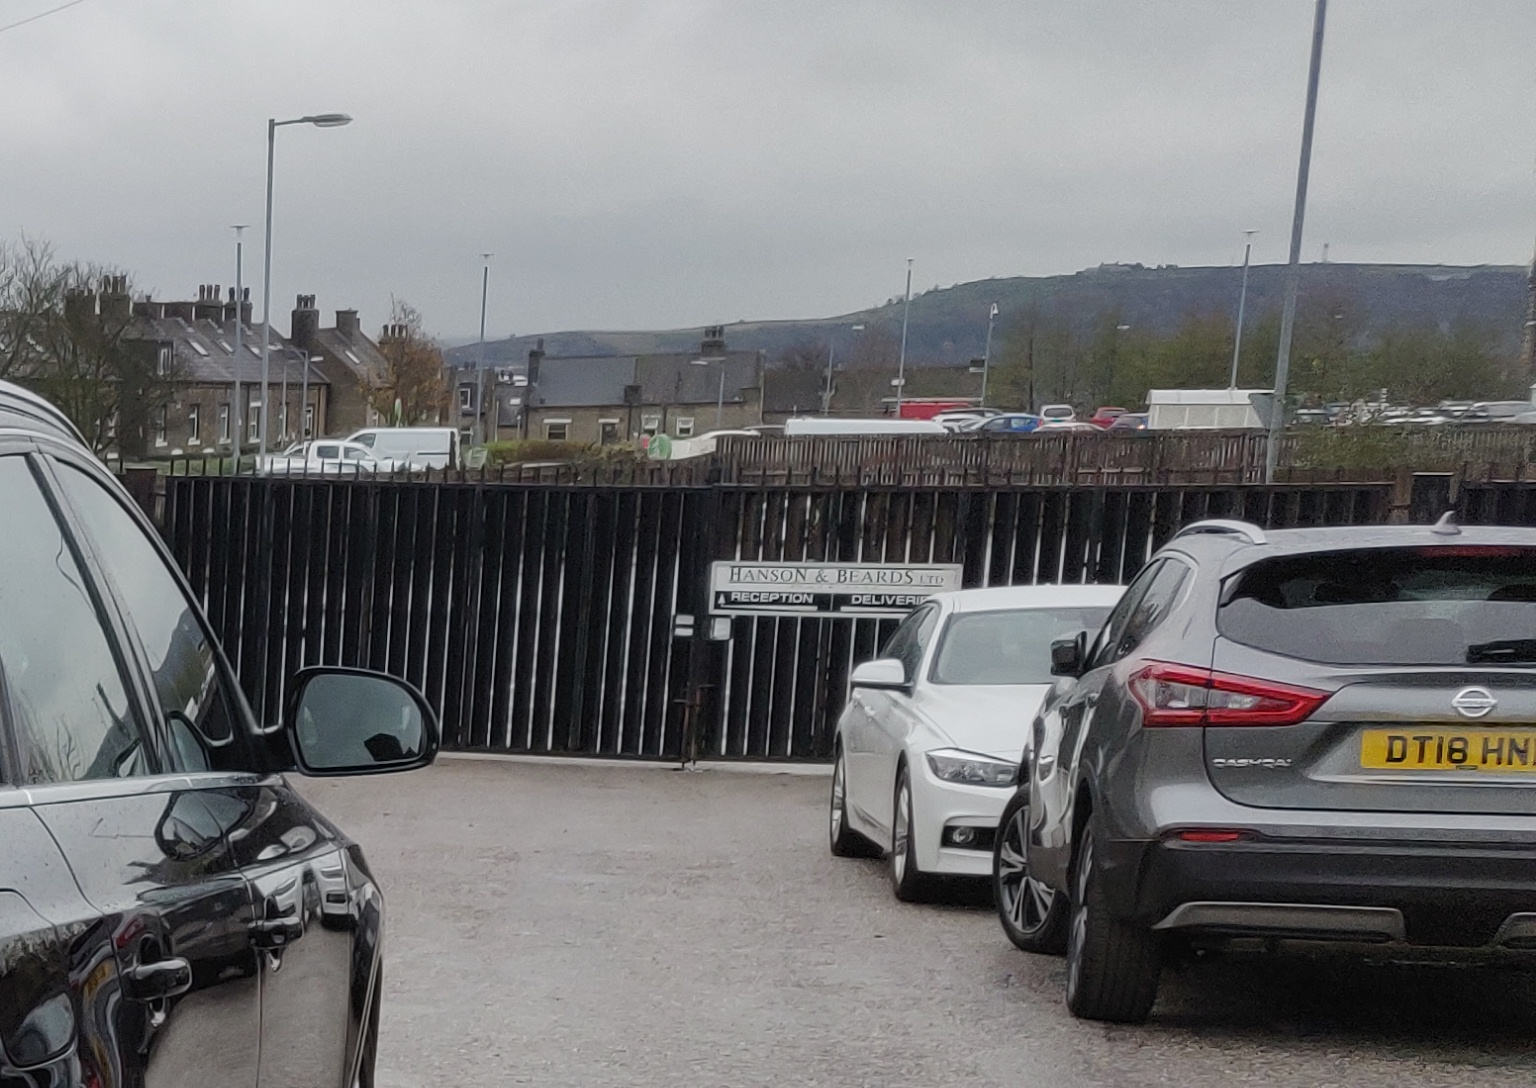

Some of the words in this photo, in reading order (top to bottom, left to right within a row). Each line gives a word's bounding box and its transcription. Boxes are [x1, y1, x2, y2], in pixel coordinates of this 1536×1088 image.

[730, 566, 808, 582] HANSON
[815, 569, 830, 583] &
[837, 569, 914, 584] BEARDS
[920, 575, 944, 584] LTD
[731, 591, 814, 604] RECEPTION
[1482, 737, 1536, 766] HN
